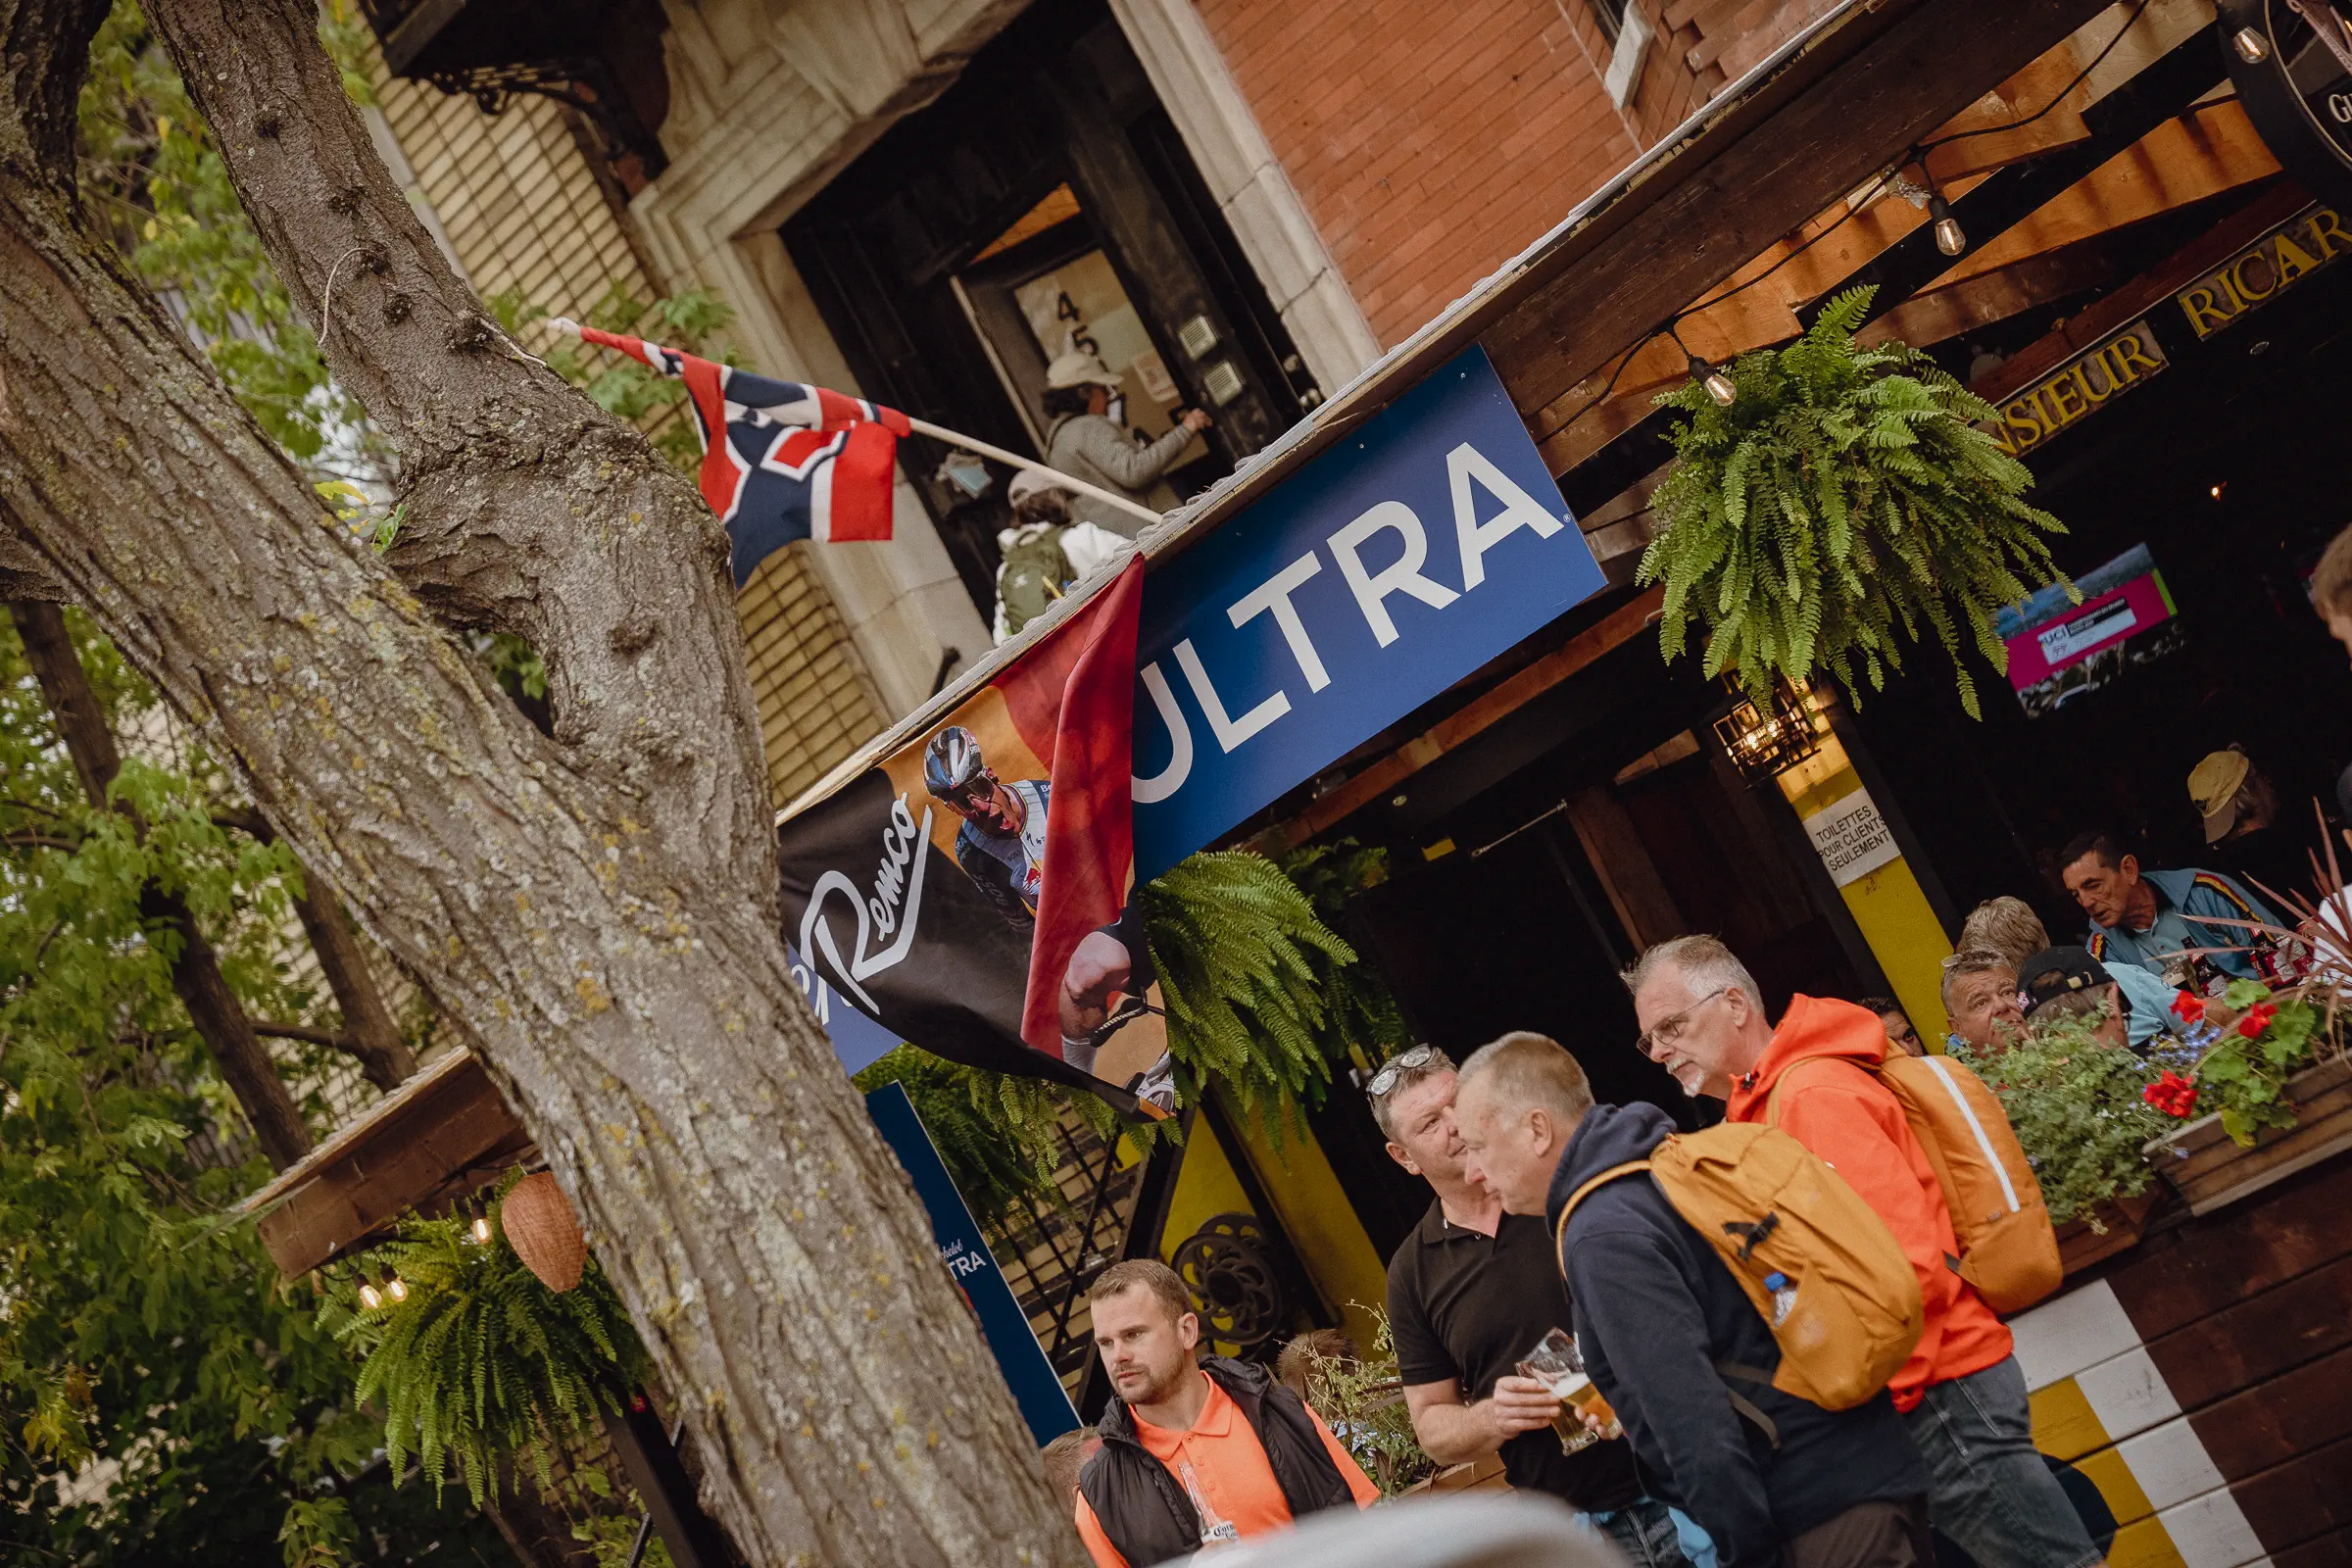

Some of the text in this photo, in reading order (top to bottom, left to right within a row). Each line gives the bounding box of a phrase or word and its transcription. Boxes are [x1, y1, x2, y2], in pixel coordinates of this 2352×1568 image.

[1130, 441, 1565, 804] ULTRA
[2043, 628, 2068, 645] UCI
[1815, 805, 1872, 844] TOILETTES
[1816, 813, 1886, 858] POUR CLIENTS
[1828, 829, 1889, 871] SEULEMENT
[800, 792, 933, 1015] Remco
